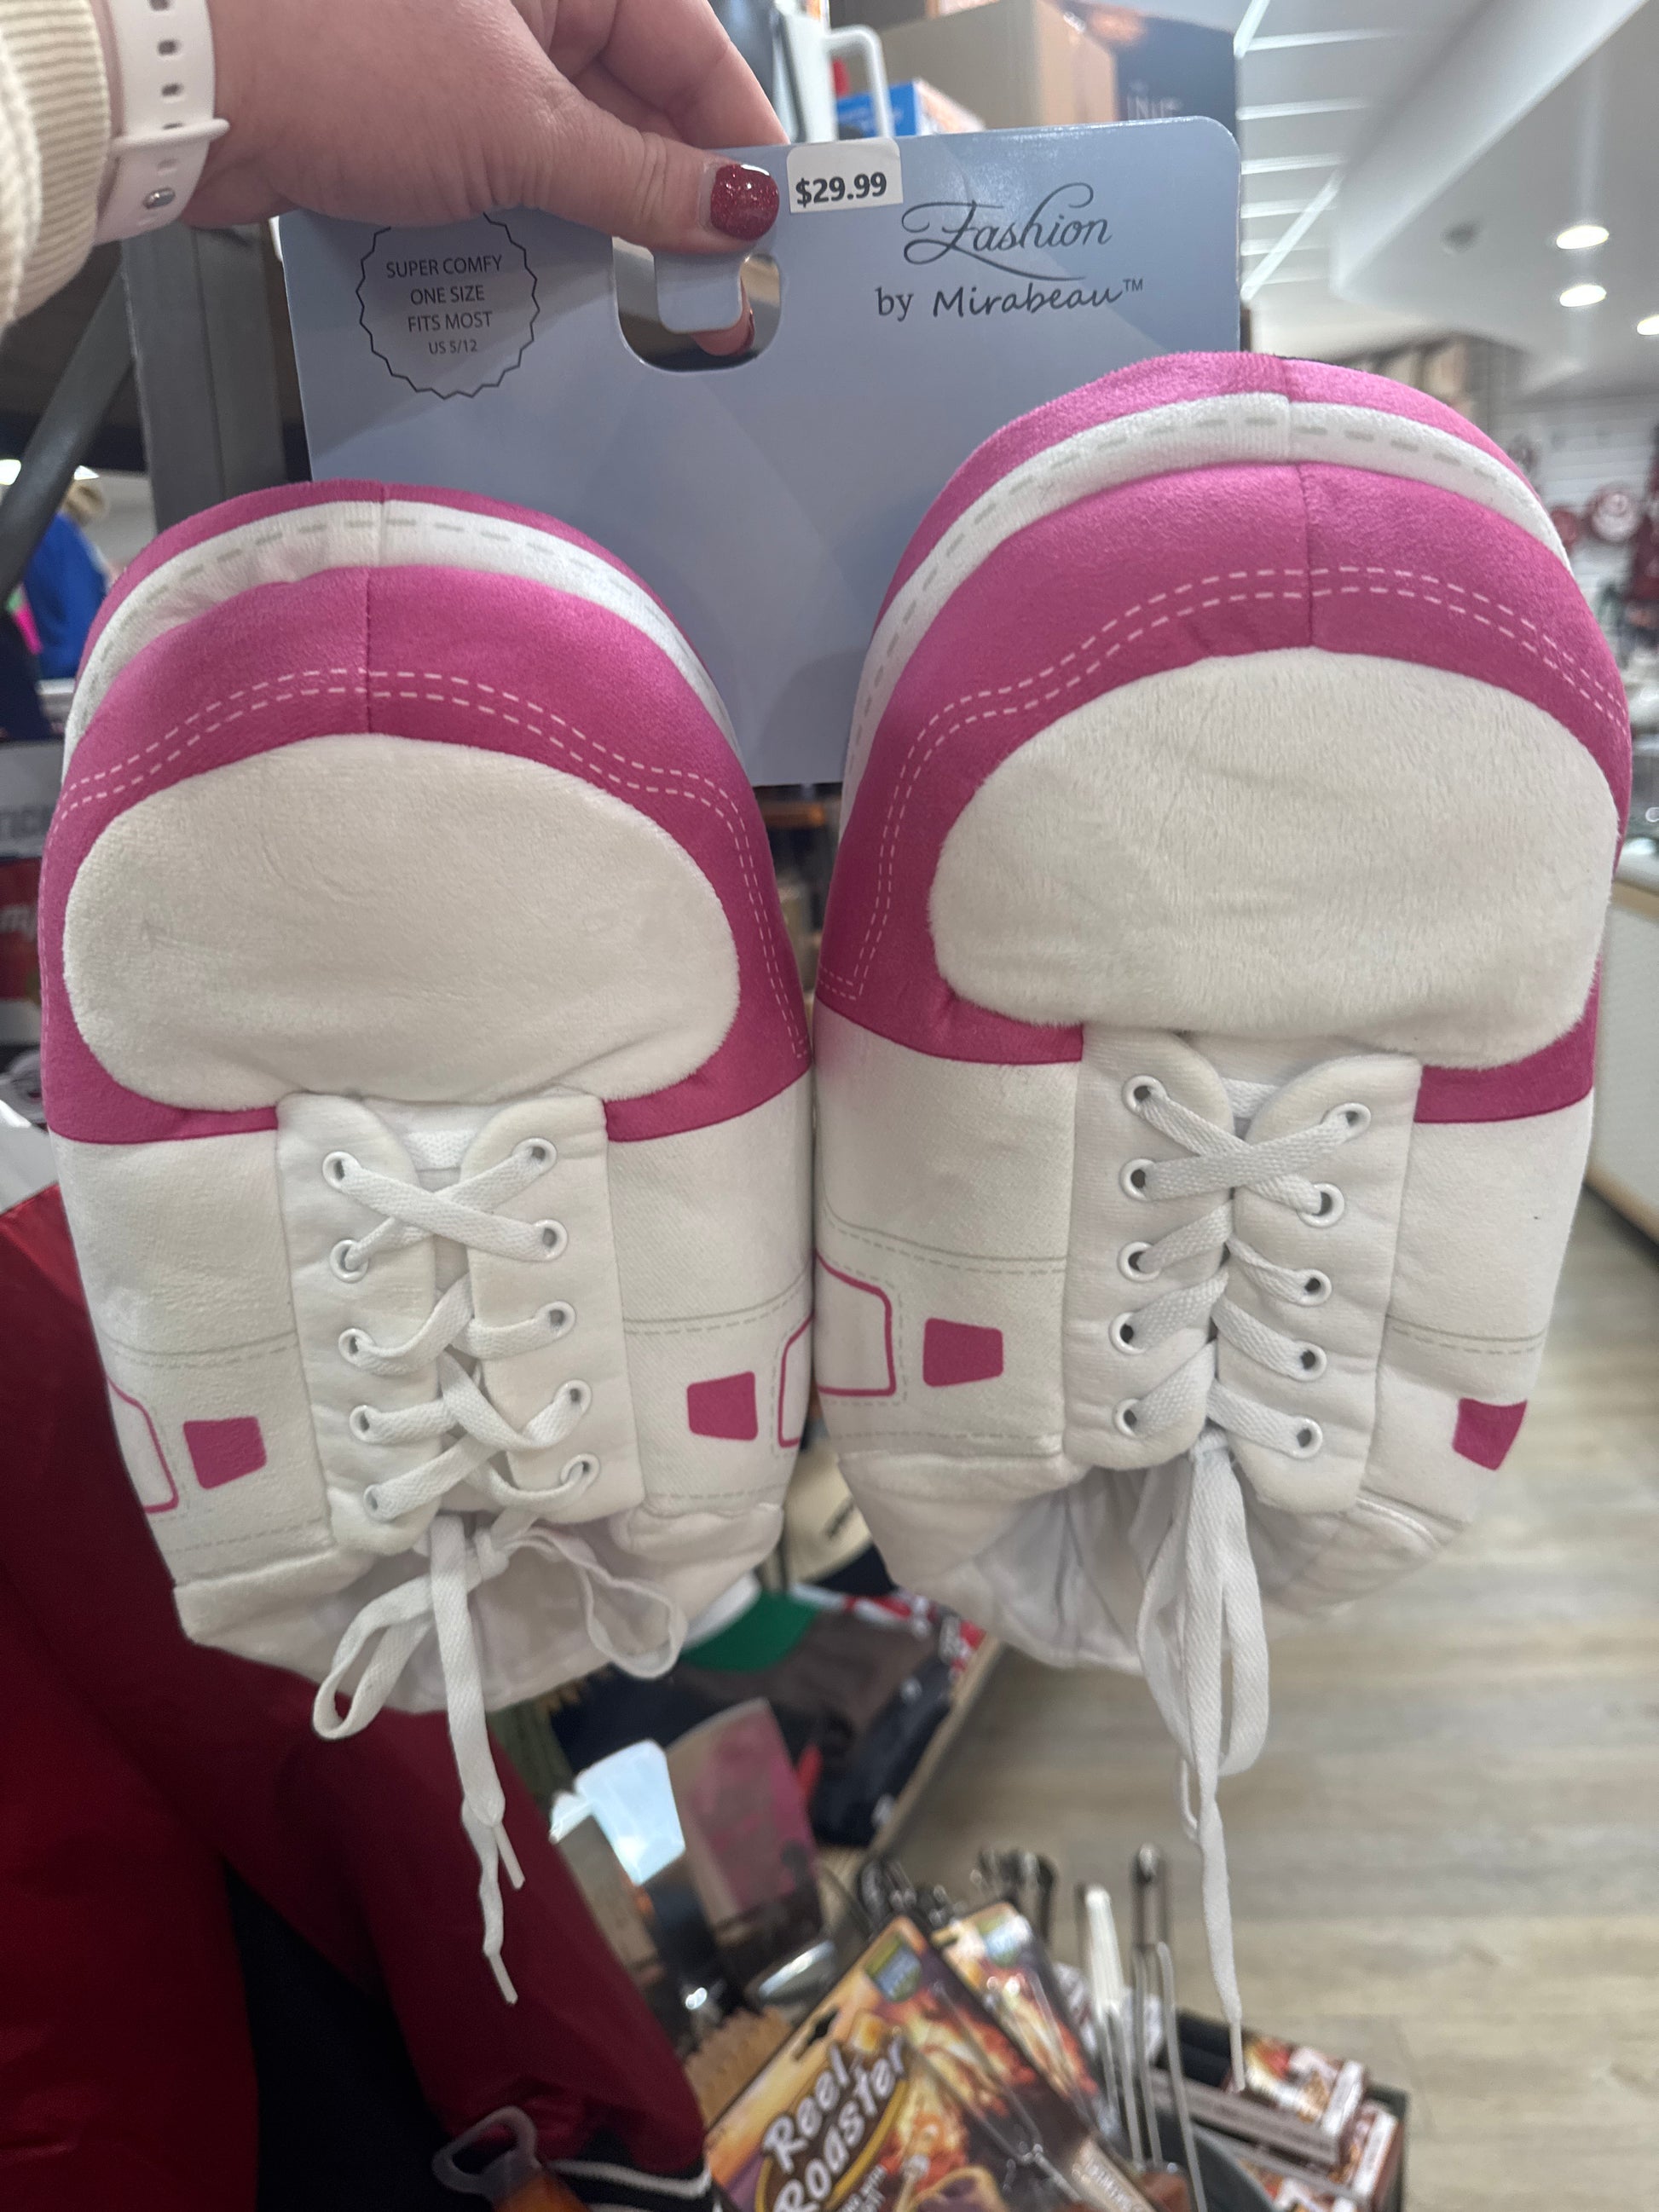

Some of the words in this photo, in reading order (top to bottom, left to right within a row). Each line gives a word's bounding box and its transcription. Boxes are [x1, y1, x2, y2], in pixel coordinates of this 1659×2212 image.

[795, 171, 887, 209] $29.99
[901, 182, 1112, 281] Fashion
[385, 258, 440, 280] SUPER
[442, 254, 503, 274] COMFY
[410, 286, 447, 306] ONE
[450, 285, 485, 303] SIZE
[875, 286, 914, 322] by
[408, 314, 441, 332] FITS
[445, 310, 493, 329] MOST
[429, 341, 447, 355] US
[449, 339, 478, 355] 5/12
[763, 2041, 851, 2174] Reel
